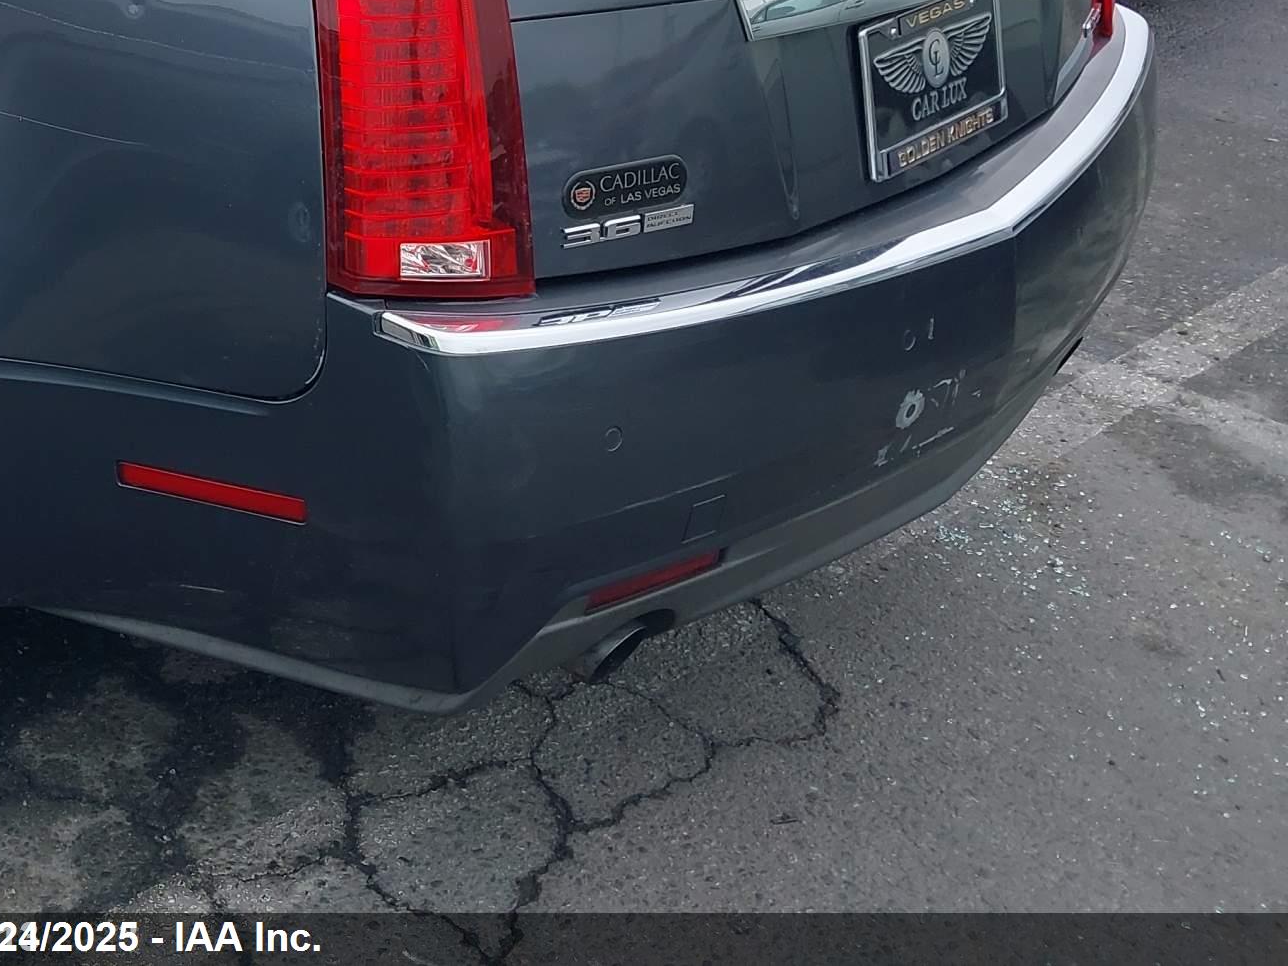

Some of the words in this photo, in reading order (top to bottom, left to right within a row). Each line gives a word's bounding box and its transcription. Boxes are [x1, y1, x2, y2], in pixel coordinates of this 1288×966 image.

[912, 90, 940, 121] CAR
[941, 77, 967, 108] LUX
[898, 130, 945, 167] GOLDEN
[946, 107, 994, 143] KNIGHTS
[600, 162, 680, 192] CADILLAC
[604, 196, 617, 207] OF
[620, 191, 642, 204] LAS
[644, 183, 681, 199] VEGAS
